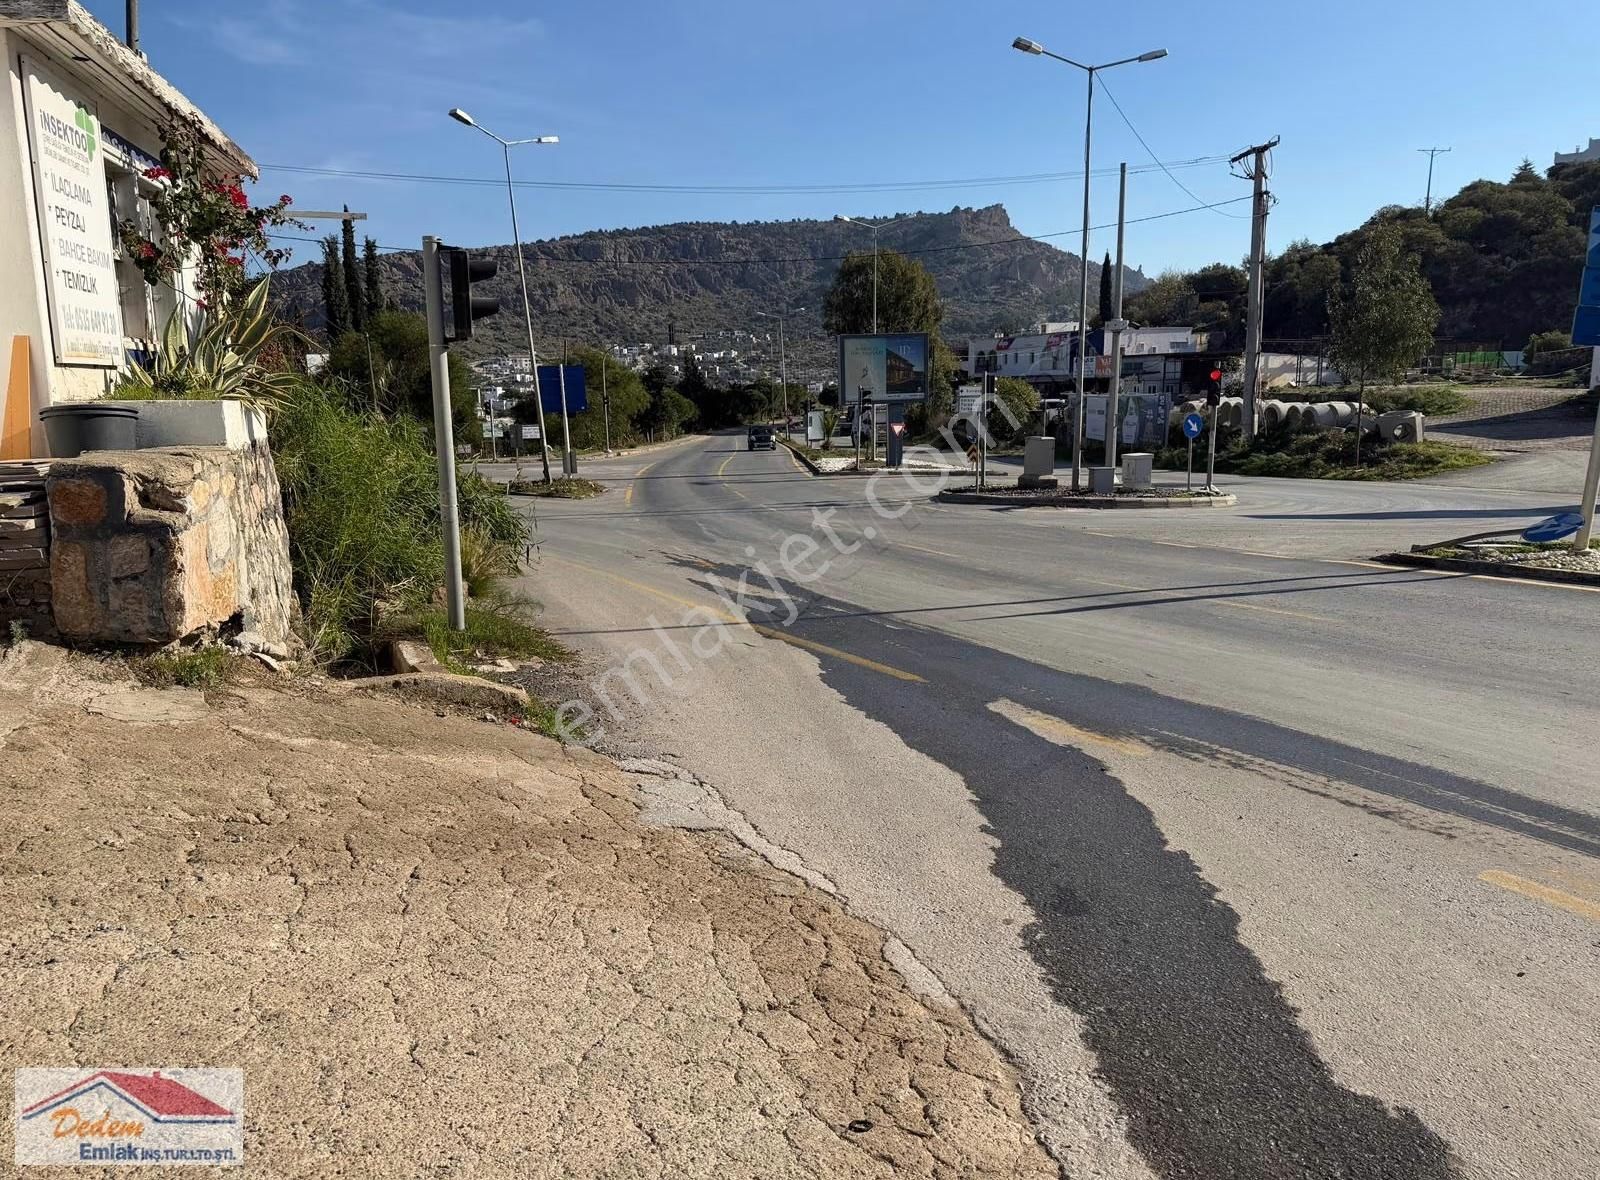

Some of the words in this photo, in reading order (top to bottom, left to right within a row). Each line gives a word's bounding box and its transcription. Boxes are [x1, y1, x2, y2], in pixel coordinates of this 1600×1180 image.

[54, 204, 86, 233] PEYZAJ
[86, 246, 111, 271] BAKIM
[61, 268, 99, 295] TEMİZLİK
